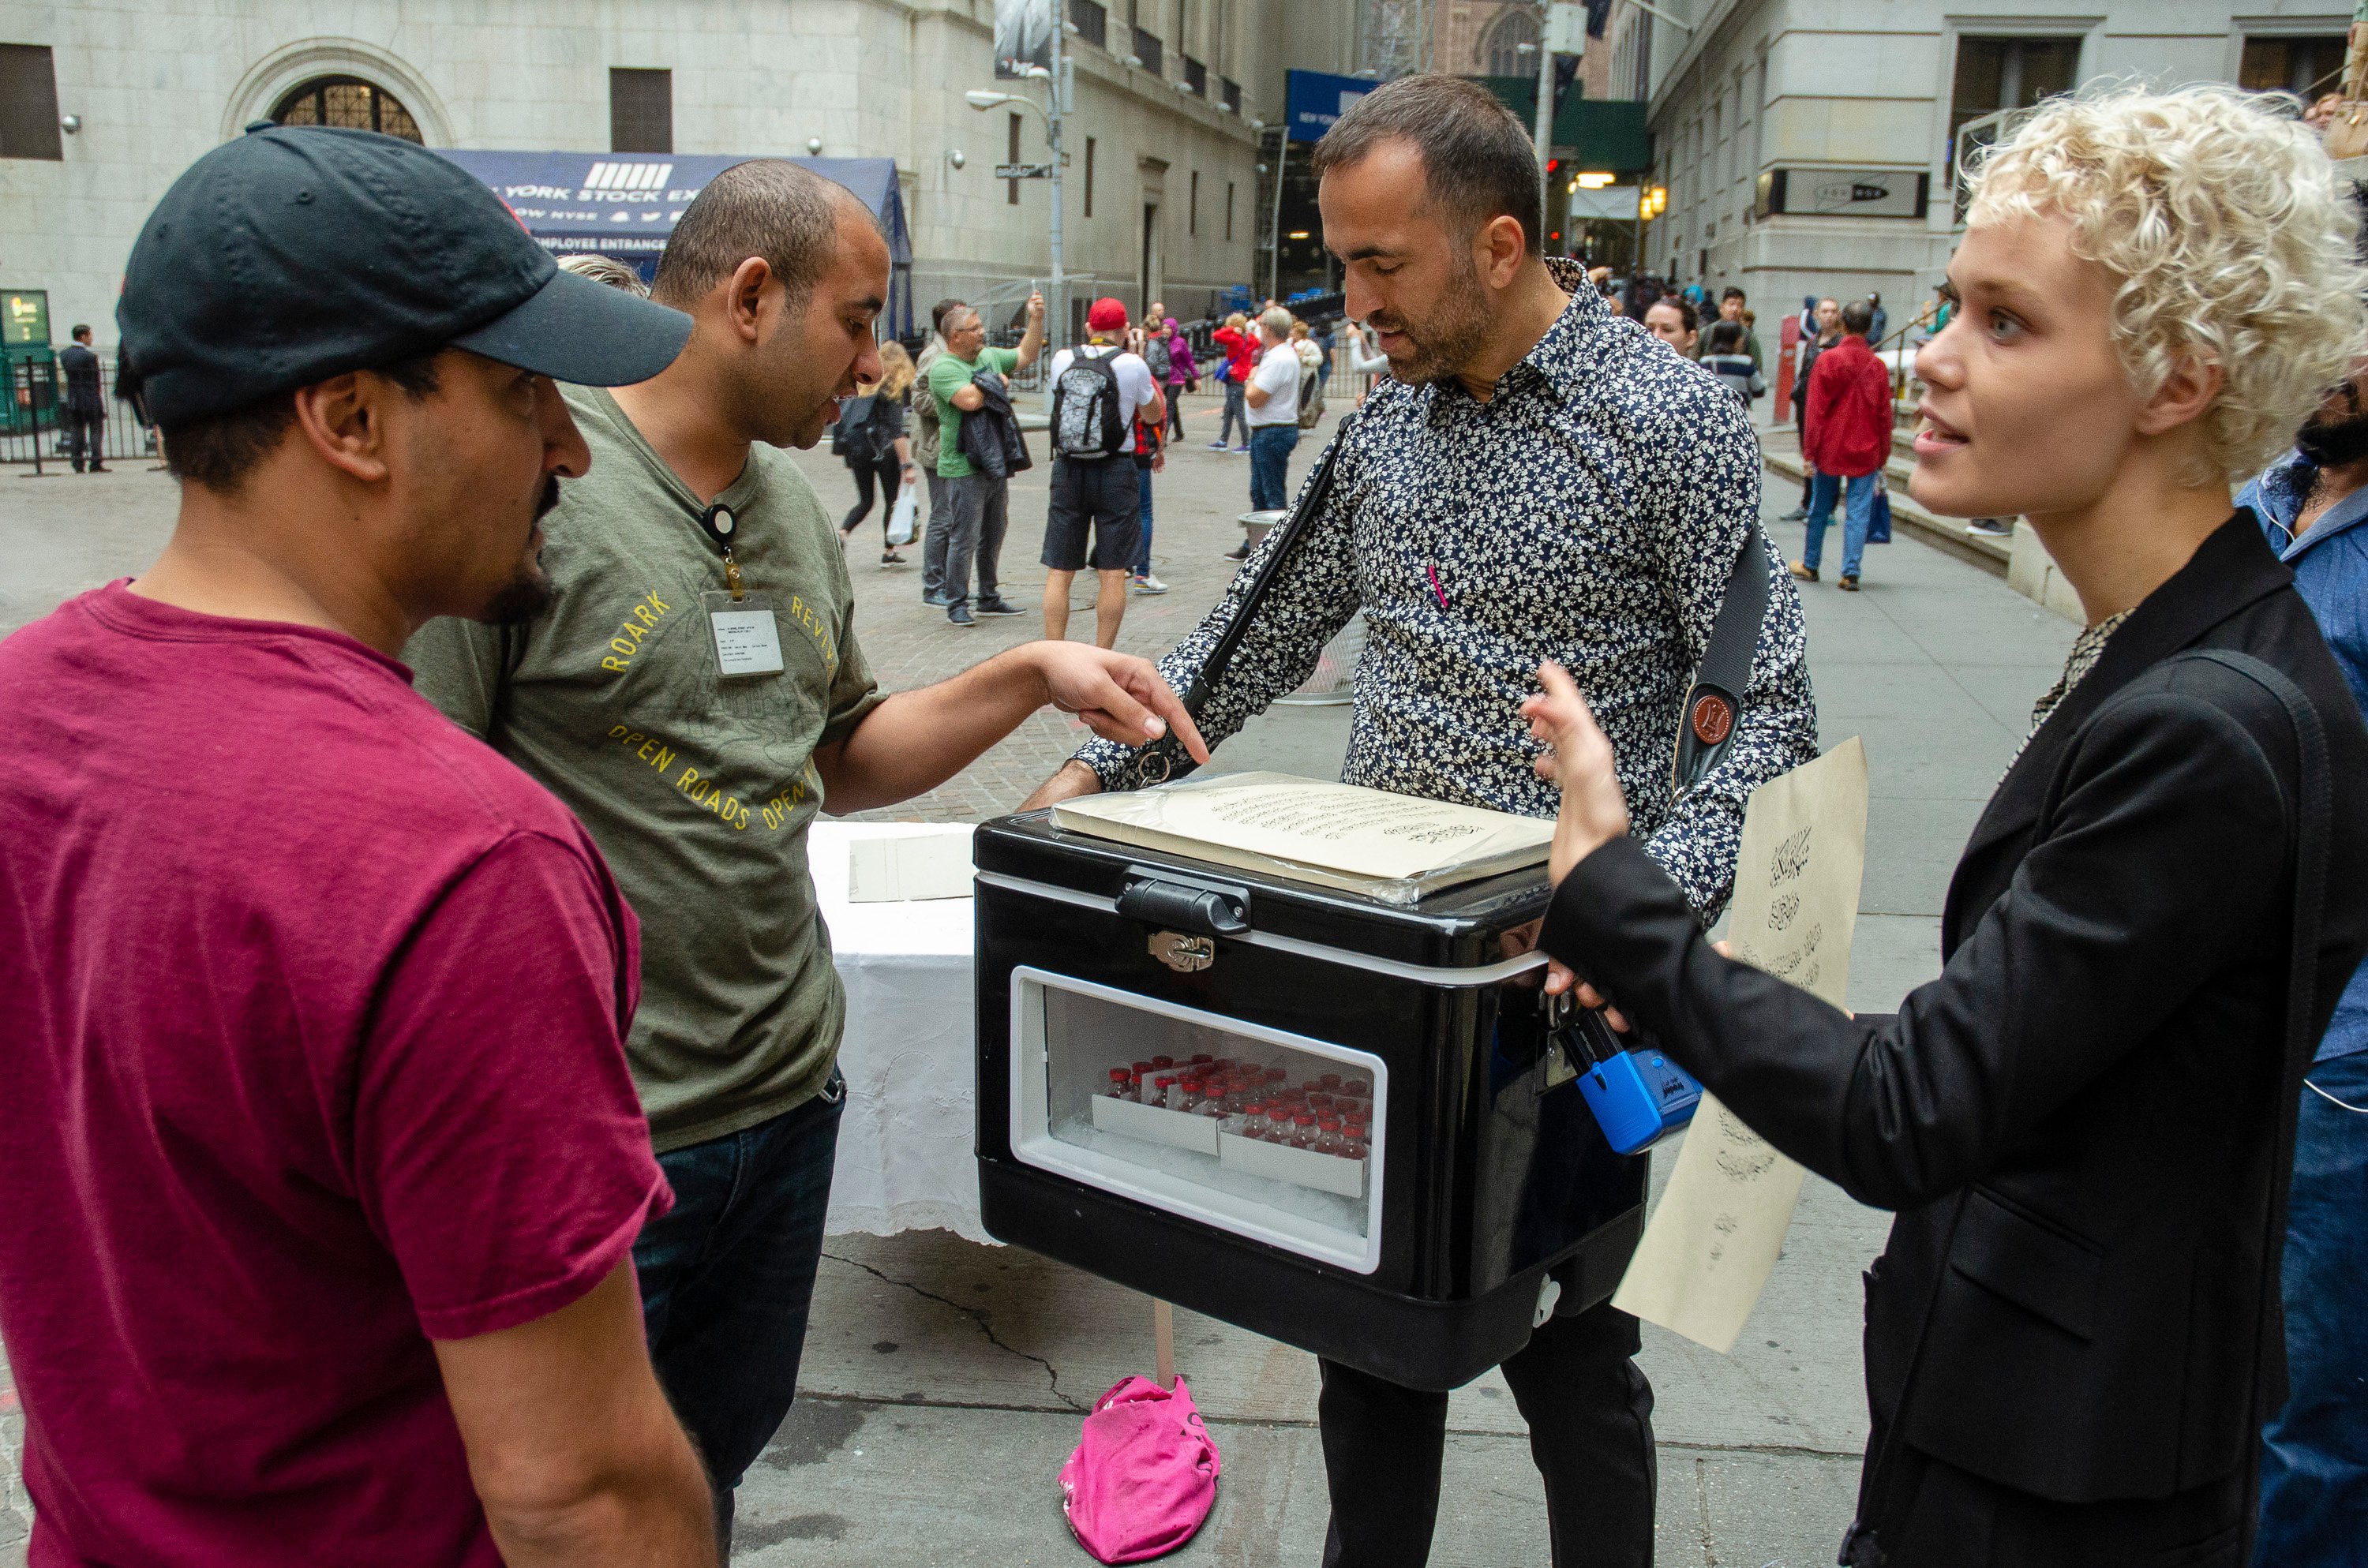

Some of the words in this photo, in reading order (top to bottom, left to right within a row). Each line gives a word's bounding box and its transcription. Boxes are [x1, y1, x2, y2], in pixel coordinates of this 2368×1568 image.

[506, 184, 572, 200] YORK
[577, 189, 661, 203] STOCK
[551, 210, 598, 221] NYSE
[599, 238, 668, 251] ENTRANCE
[601, 589, 671, 673] ROARK
[608, 724, 676, 773] OPEN
[676, 766, 751, 830] ROADS
[762, 780, 805, 831] OPEN
